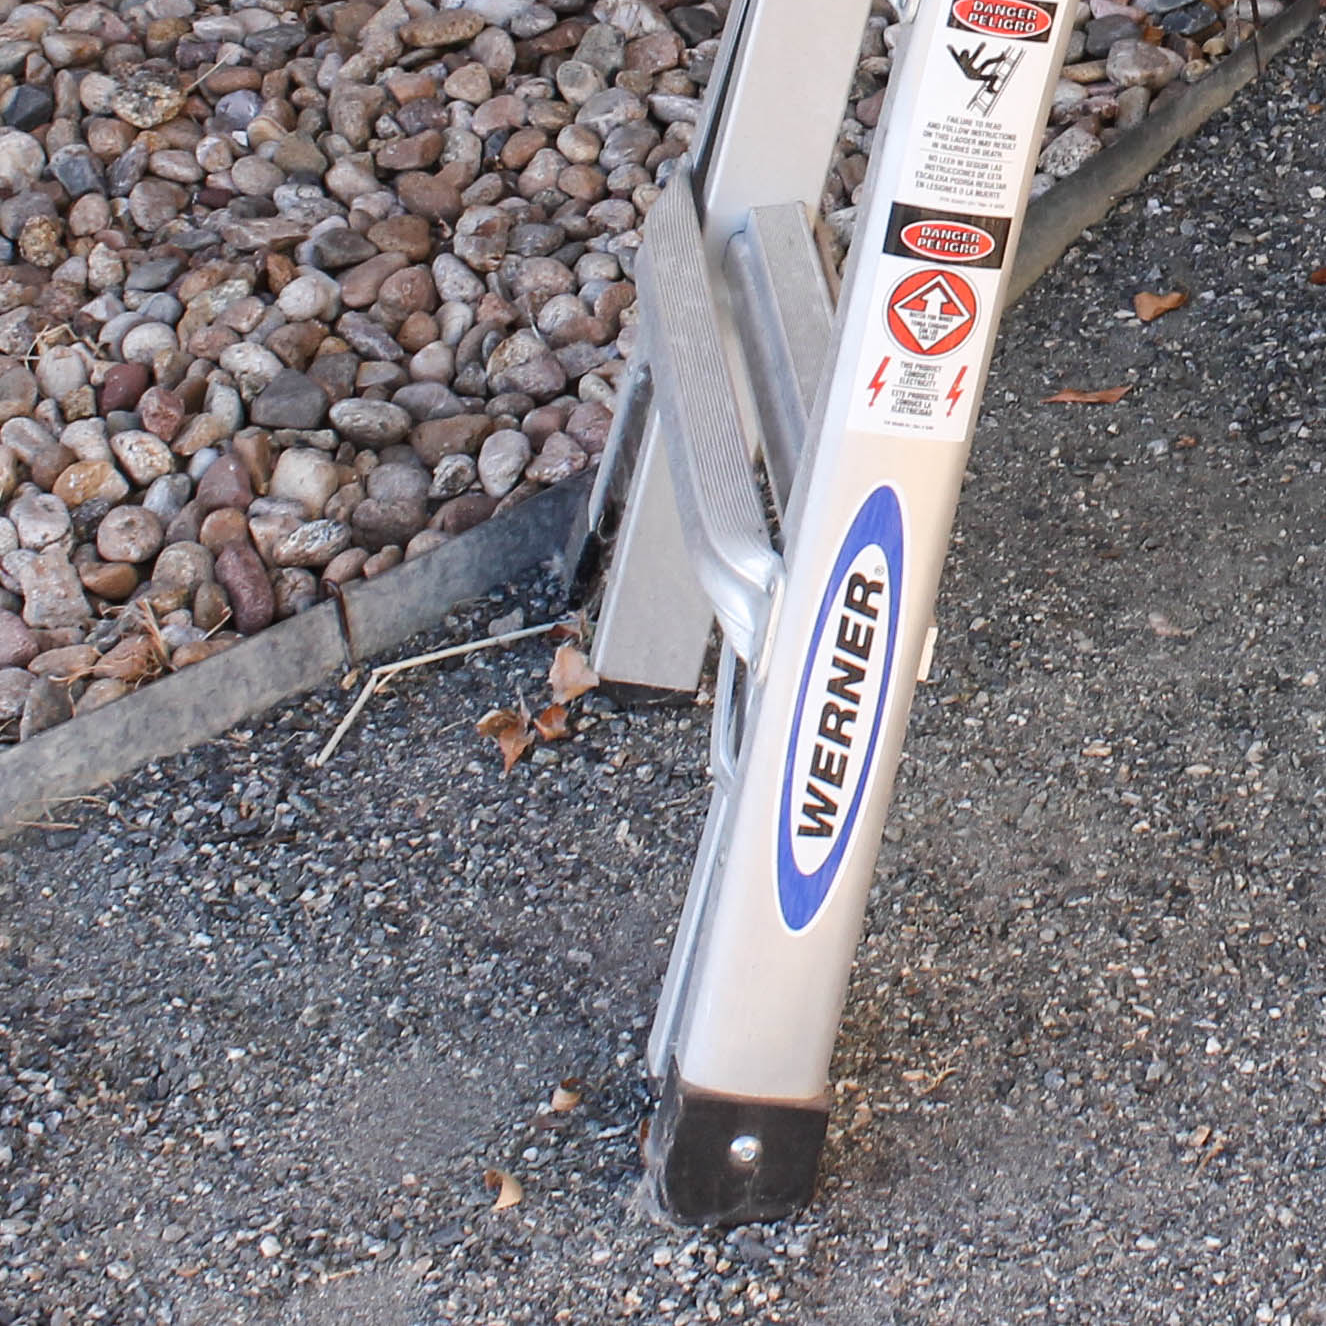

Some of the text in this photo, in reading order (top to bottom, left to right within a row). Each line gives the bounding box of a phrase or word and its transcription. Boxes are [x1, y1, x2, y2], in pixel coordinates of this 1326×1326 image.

[972, 1, 1037, 19] DANGER
[967, 14, 1035, 32] PELIGRO
[946, 116, 1001, 129] FAILURE TO READ
[922, 130, 932, 138] ON
[934, 132, 949, 140] THIS
[951, 135, 976, 144] LADDER
[993, 141, 1016, 149] RESULT
[942, 125, 969, 134] FOLLOW
[971, 129, 1016, 140] INSTRUCTIONS
[921, 227, 980, 241] DANGER
[917, 238, 979, 253] PELIGRO
[915, 363, 941, 371] PRODUCT
[899, 377, 936, 387] ELECTRICITY
[891, 389, 938, 400] ESTE PRODUCTO
[896, 398, 922, 406] CONDUCE
[890, 406, 933, 416] ELECTRICIDAD
[797, 572, 884, 838] WERNER
